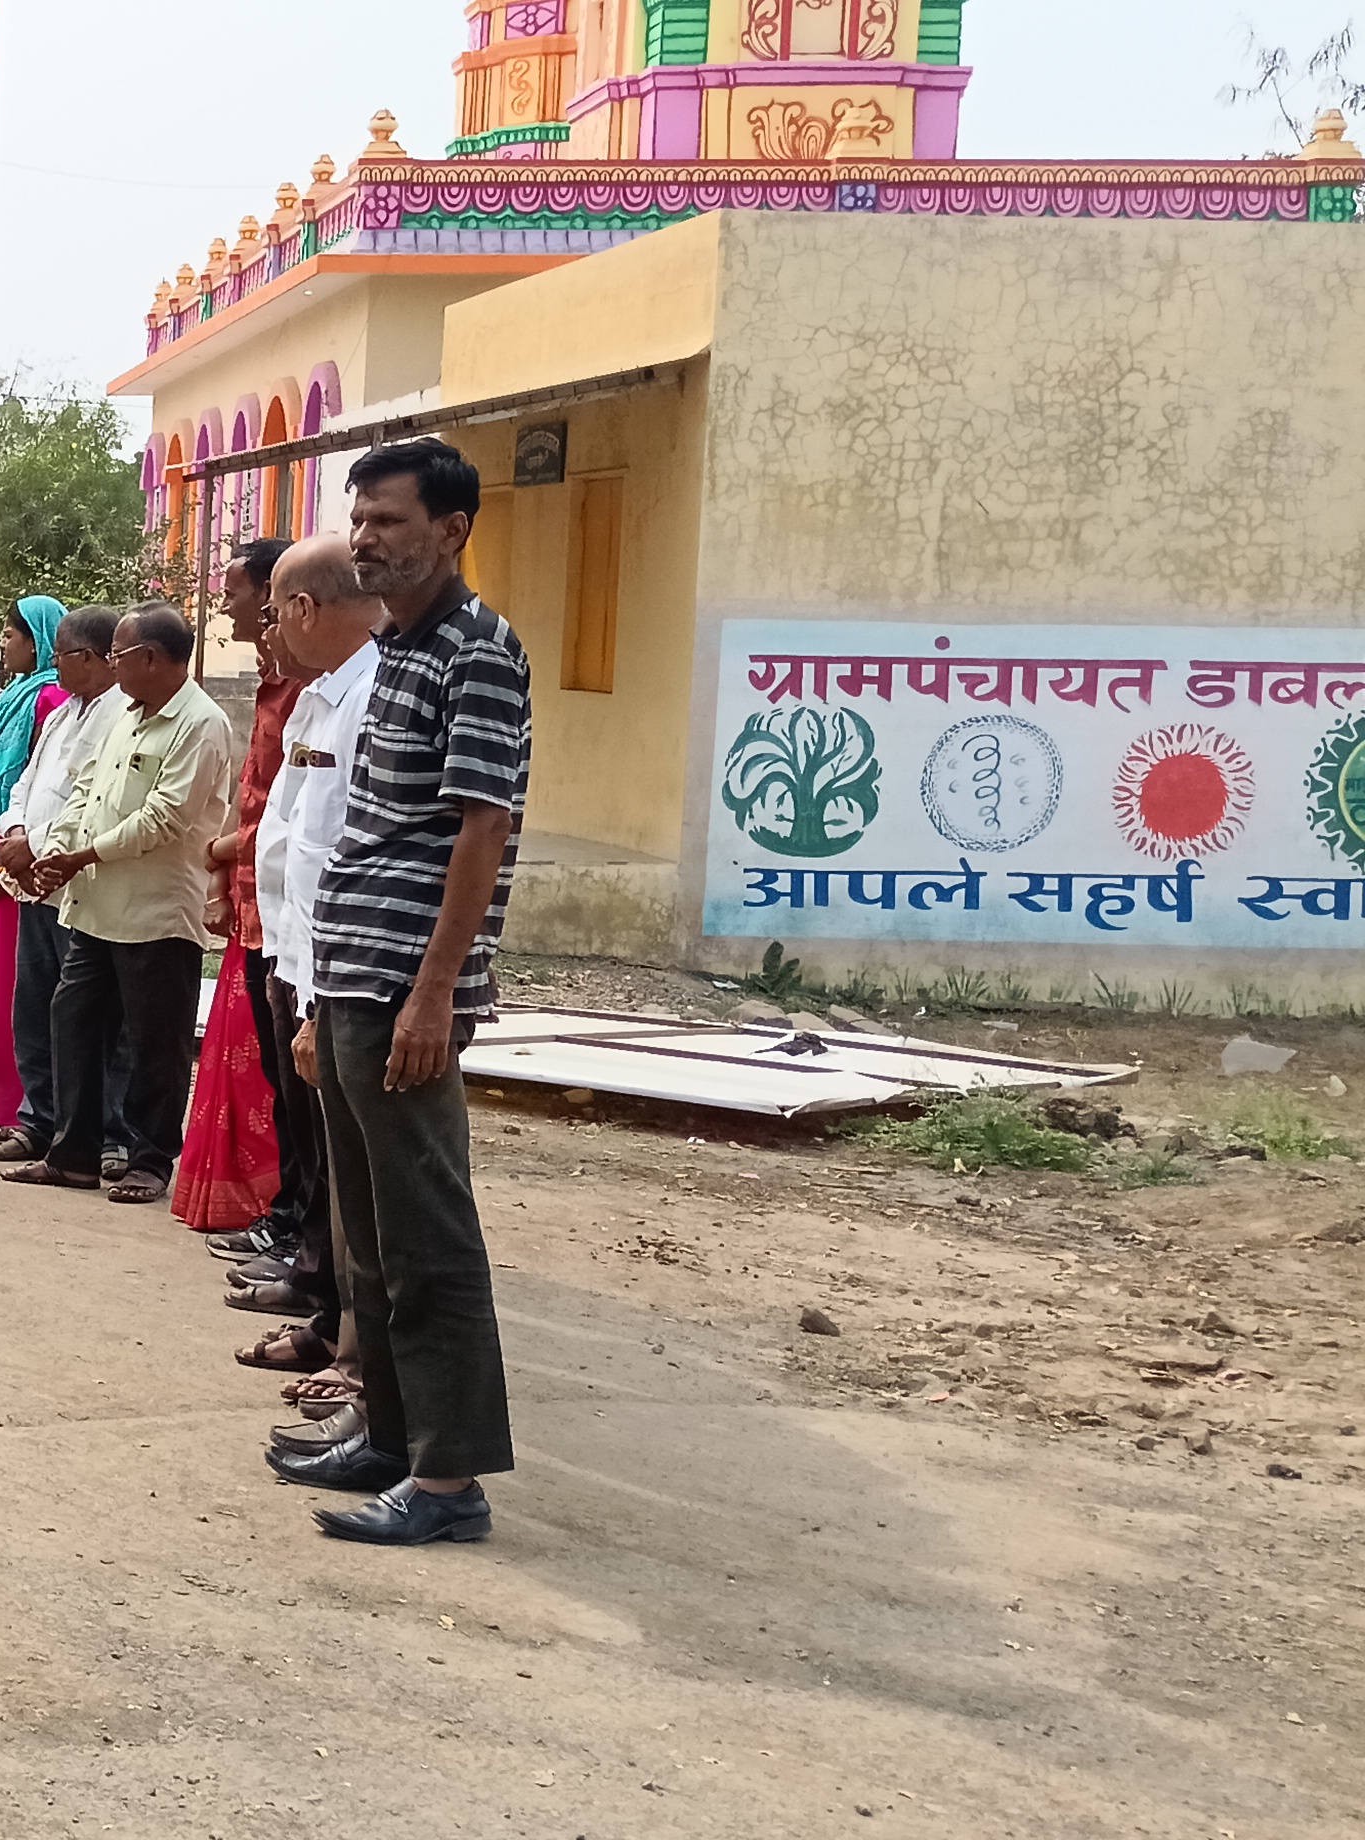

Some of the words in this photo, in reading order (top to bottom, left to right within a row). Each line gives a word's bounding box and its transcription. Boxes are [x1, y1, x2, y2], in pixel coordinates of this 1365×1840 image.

[748, 636, 1168, 714] ग्रामपंचायत
[742, 858, 987, 912] आपले
[1007, 859, 1207, 931] सहर्ष
